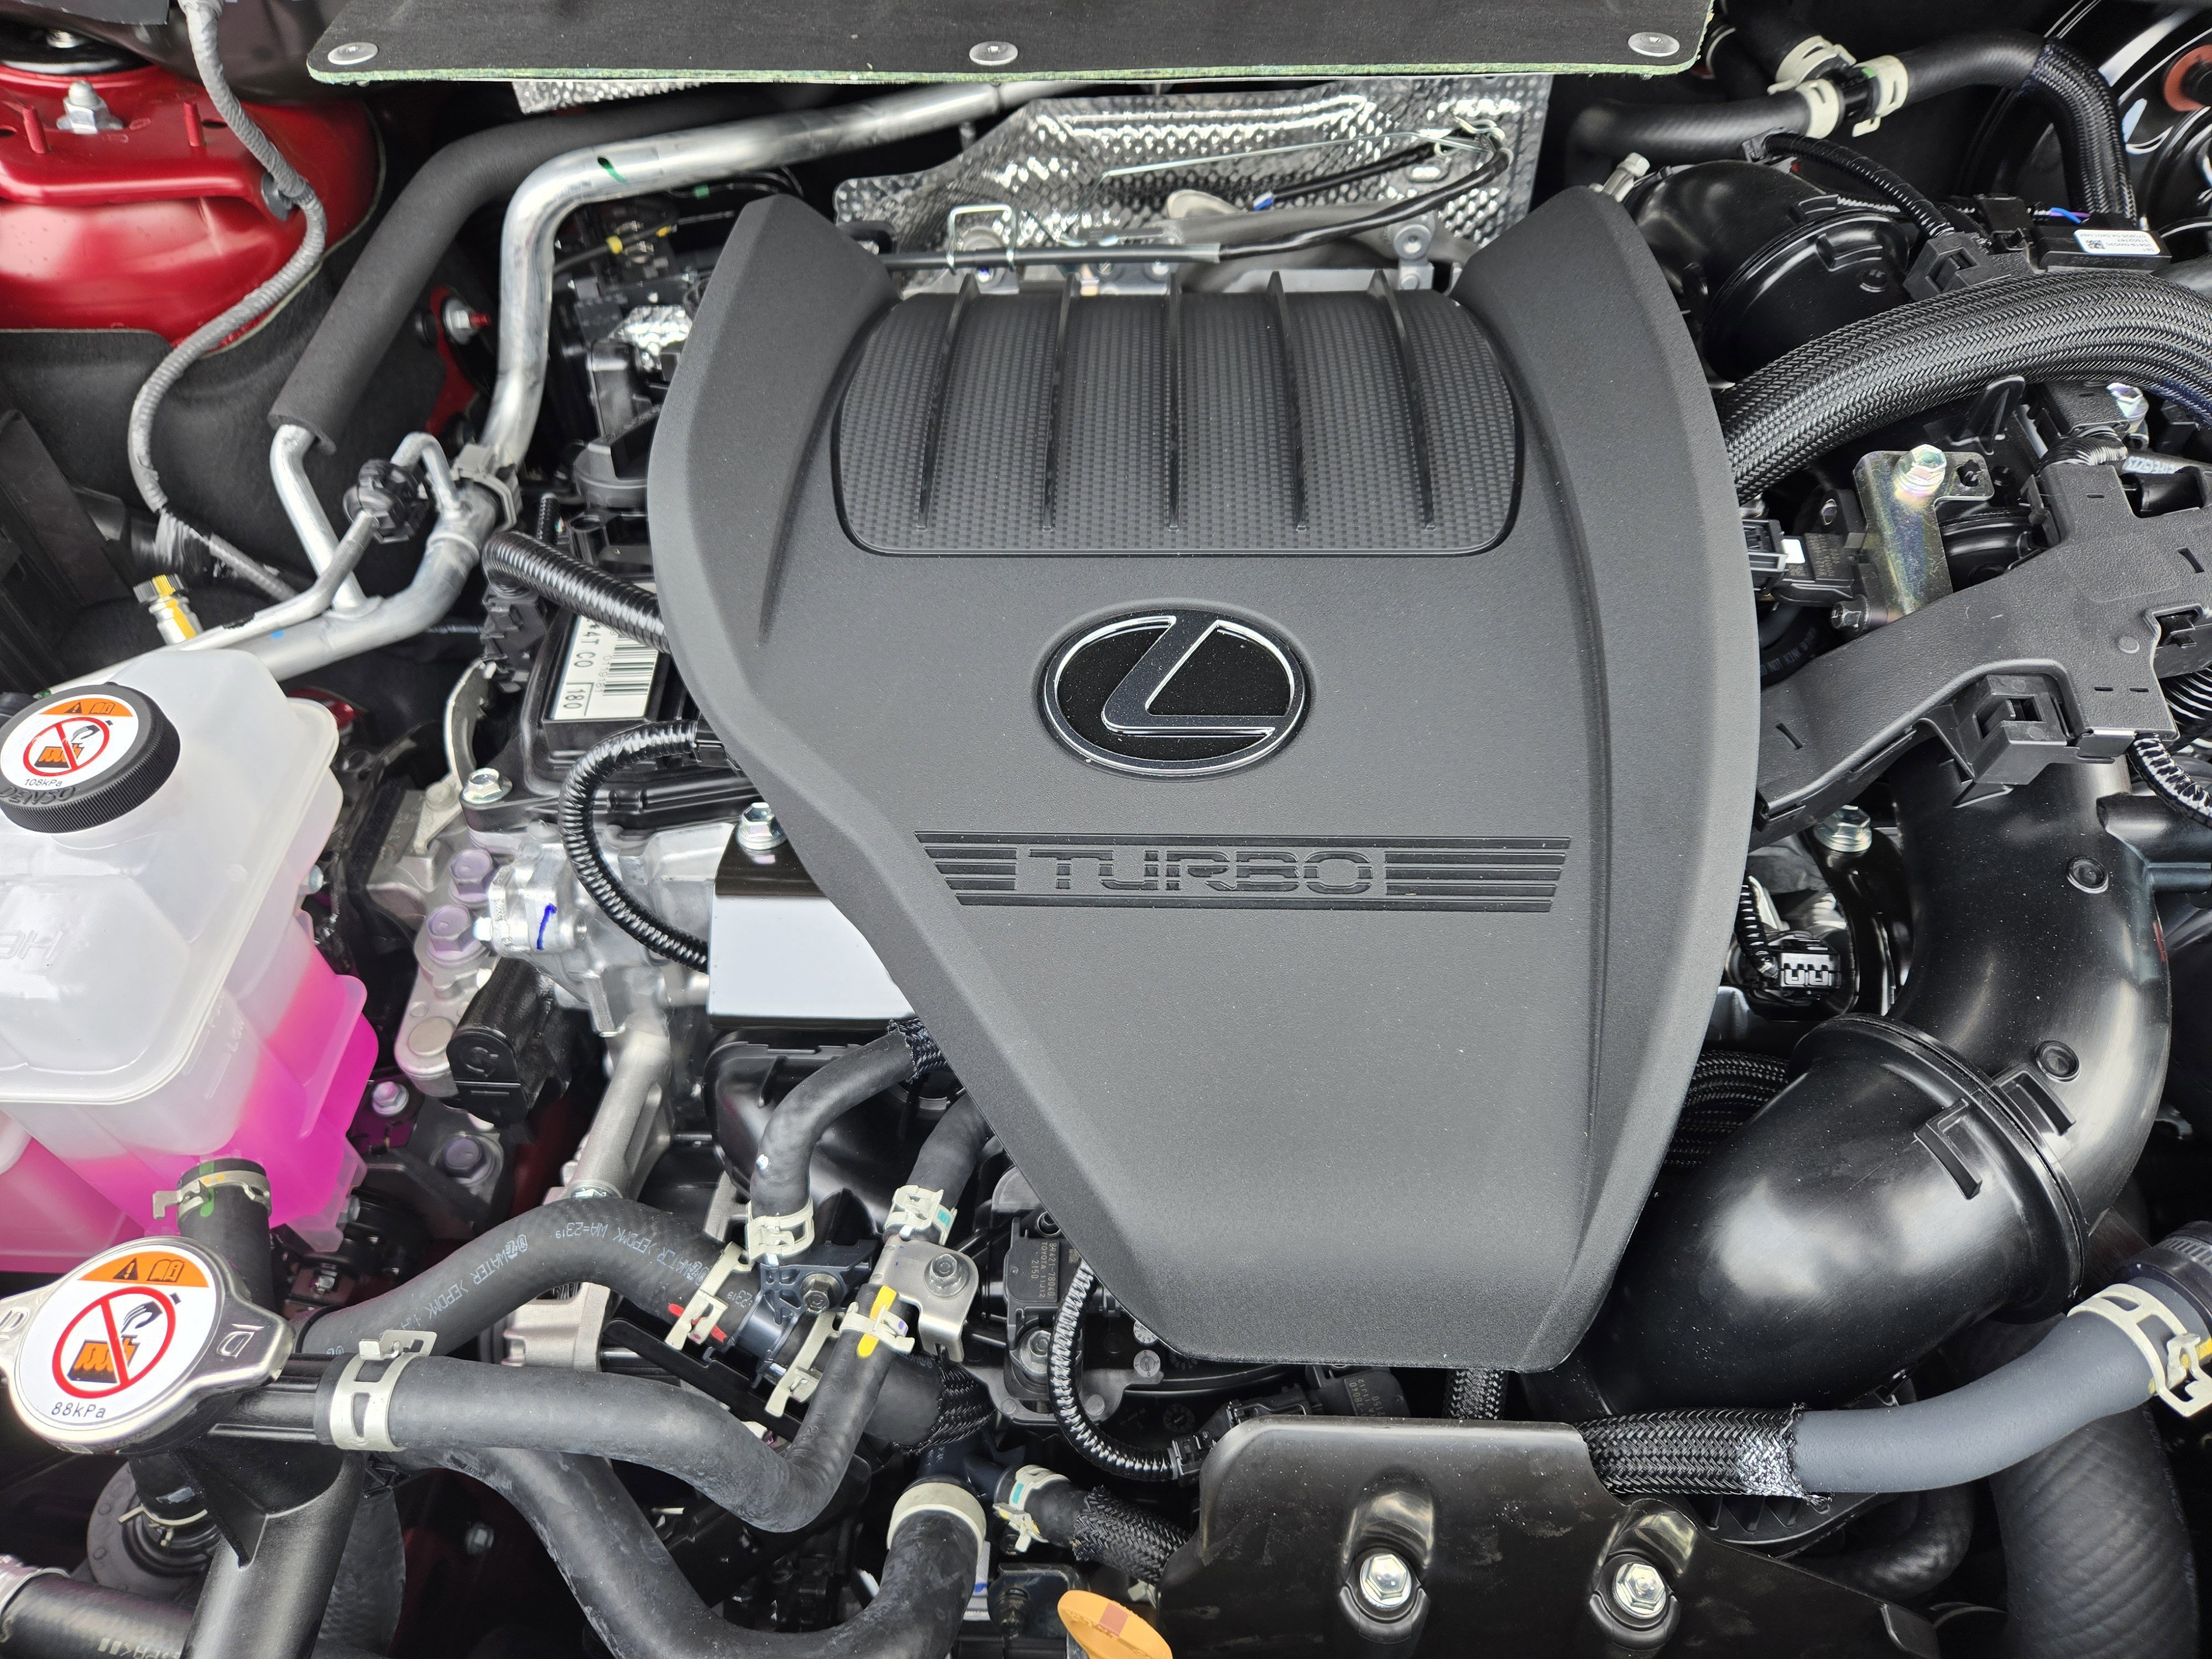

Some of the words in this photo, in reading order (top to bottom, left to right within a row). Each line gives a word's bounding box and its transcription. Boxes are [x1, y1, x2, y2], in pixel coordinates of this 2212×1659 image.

[594, 655, 612, 692] 0119181
[563, 689, 586, 709] 180
[25, 778, 63, 787] 108kPa
[0, 785, 76, 805] DENSO
[1028, 848, 1372, 895] TURBO
[470, 1251, 509, 1285] WATER
[1031, 1260, 1040, 1279] 2150
[1047, 1243, 1057, 1296] 89421-78040
[51, 1401, 106, 1418] 88kPa
